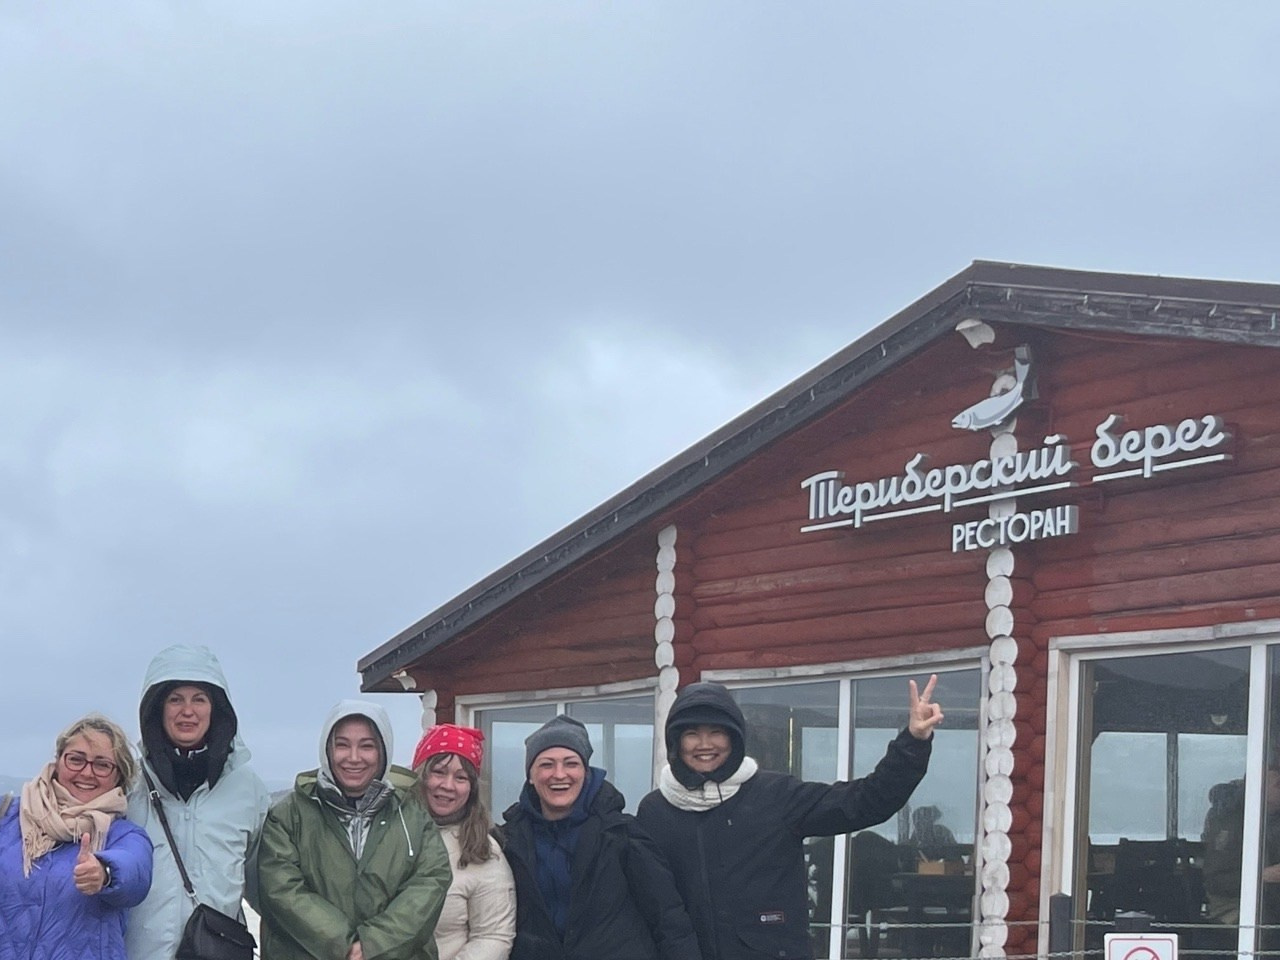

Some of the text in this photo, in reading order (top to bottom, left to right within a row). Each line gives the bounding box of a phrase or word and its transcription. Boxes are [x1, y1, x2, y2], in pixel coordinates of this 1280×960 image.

[800, 414, 1225, 529] Териберский берег
[952, 505, 1071, 553] РЕСТОРАН
